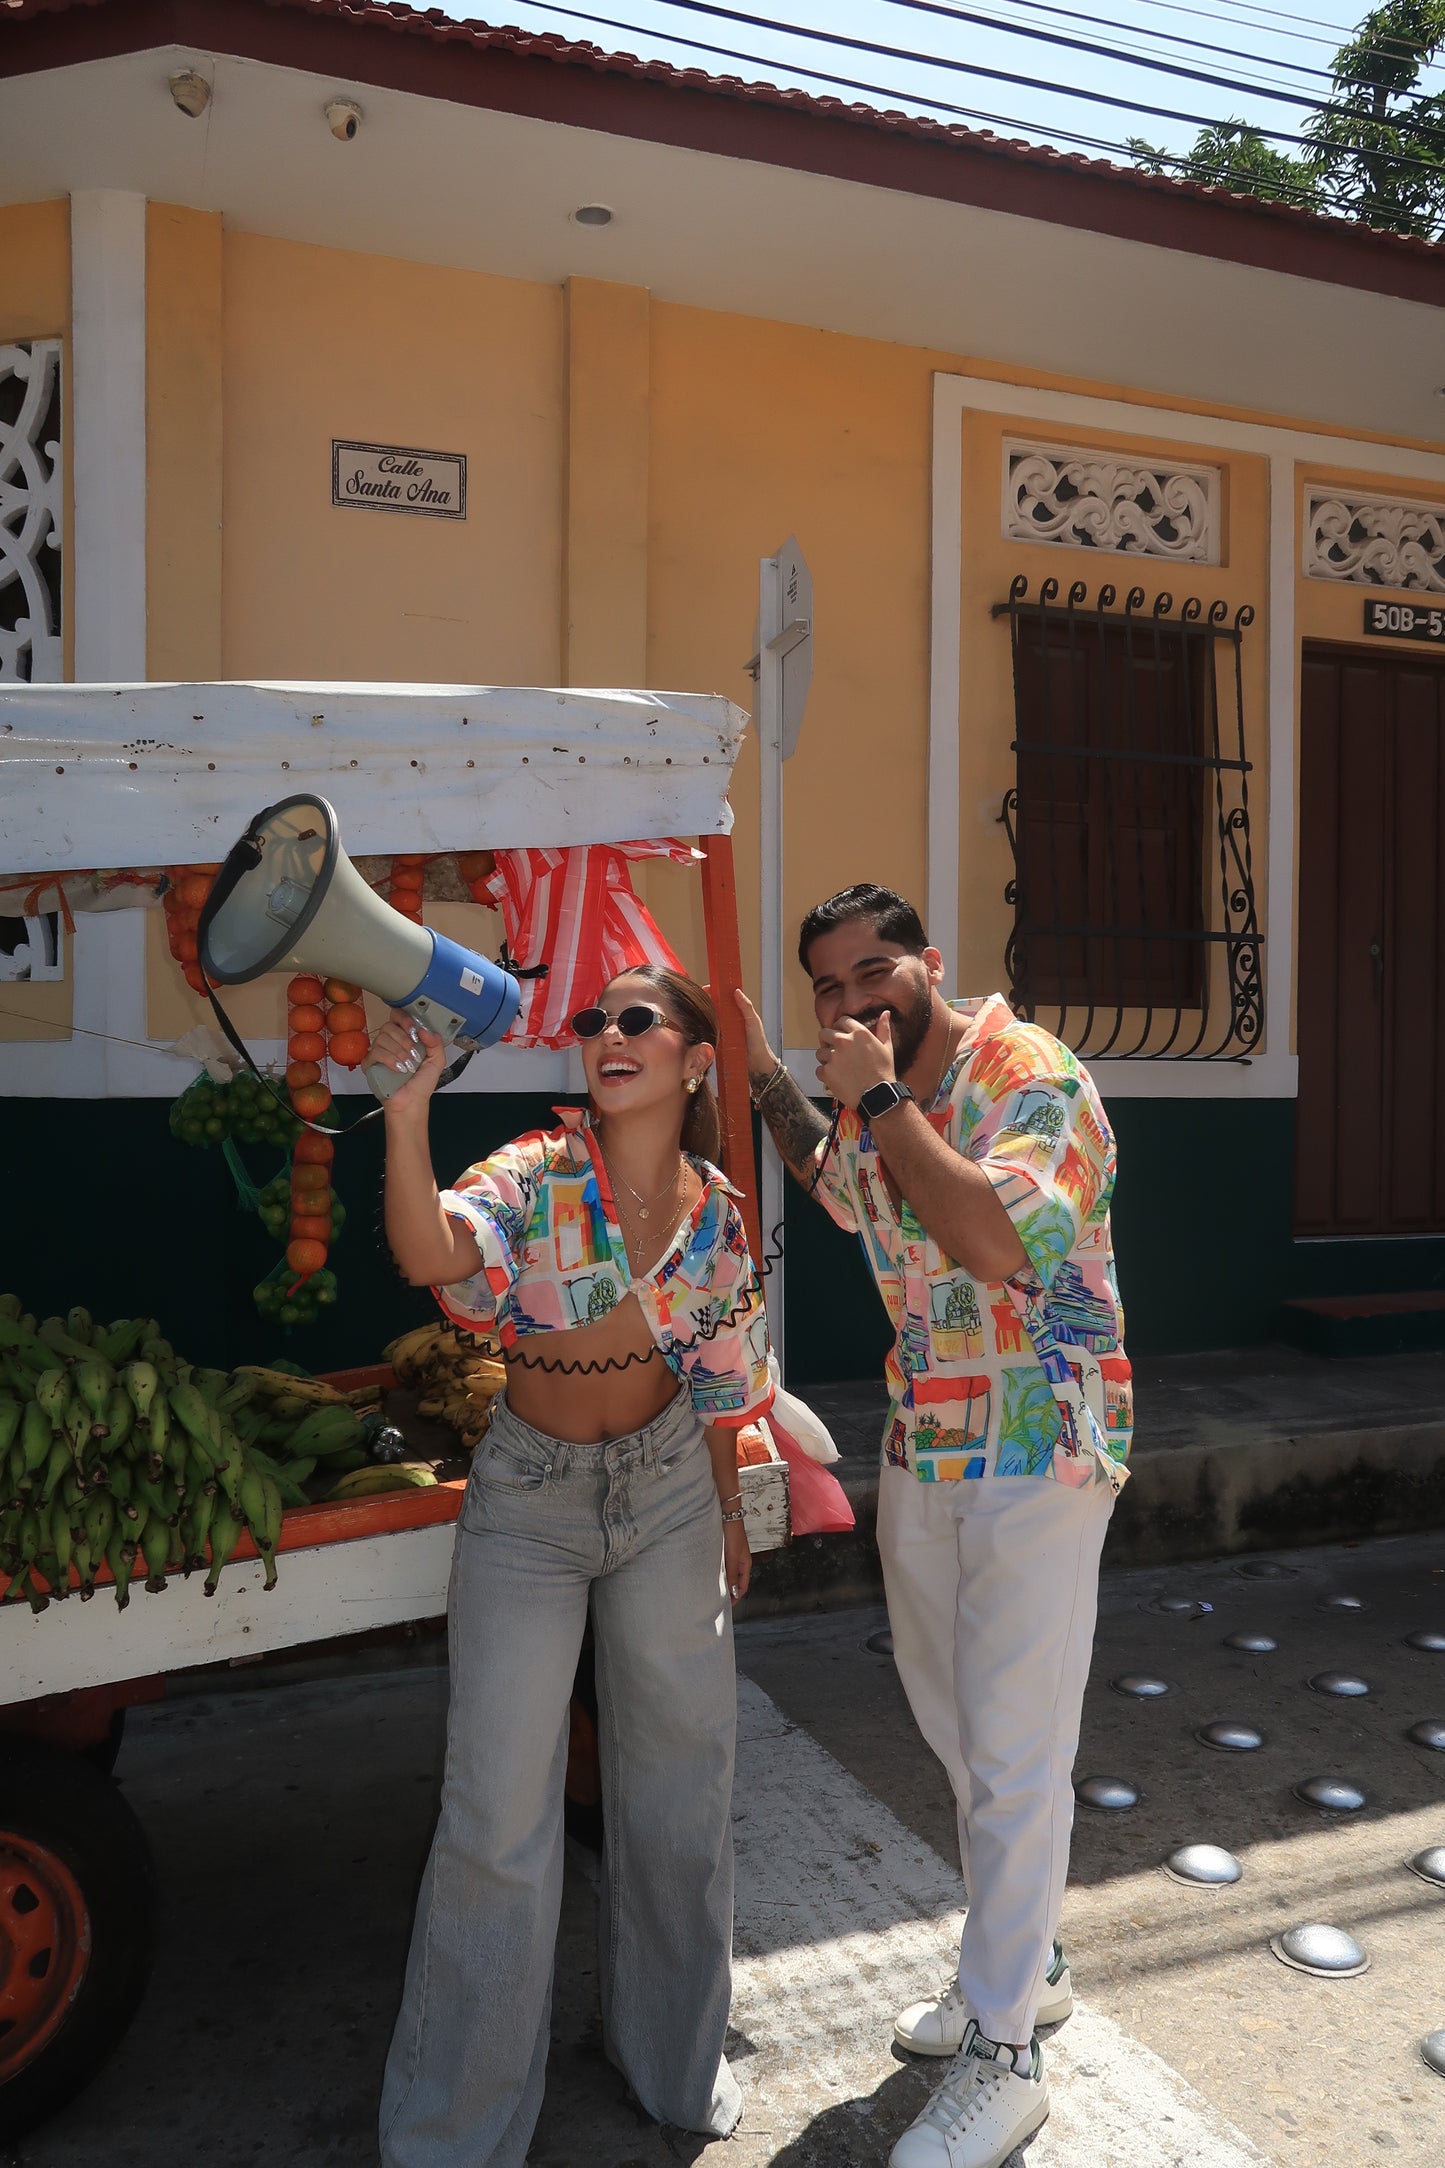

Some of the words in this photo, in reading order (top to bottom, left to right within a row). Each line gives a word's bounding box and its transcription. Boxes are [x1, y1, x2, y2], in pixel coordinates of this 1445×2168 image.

[378, 456, 424, 476] Calle
[346, 469, 402, 499] Santa
[407, 479, 451, 504] Ana
[1373, 604, 1445, 636] 50B-5
